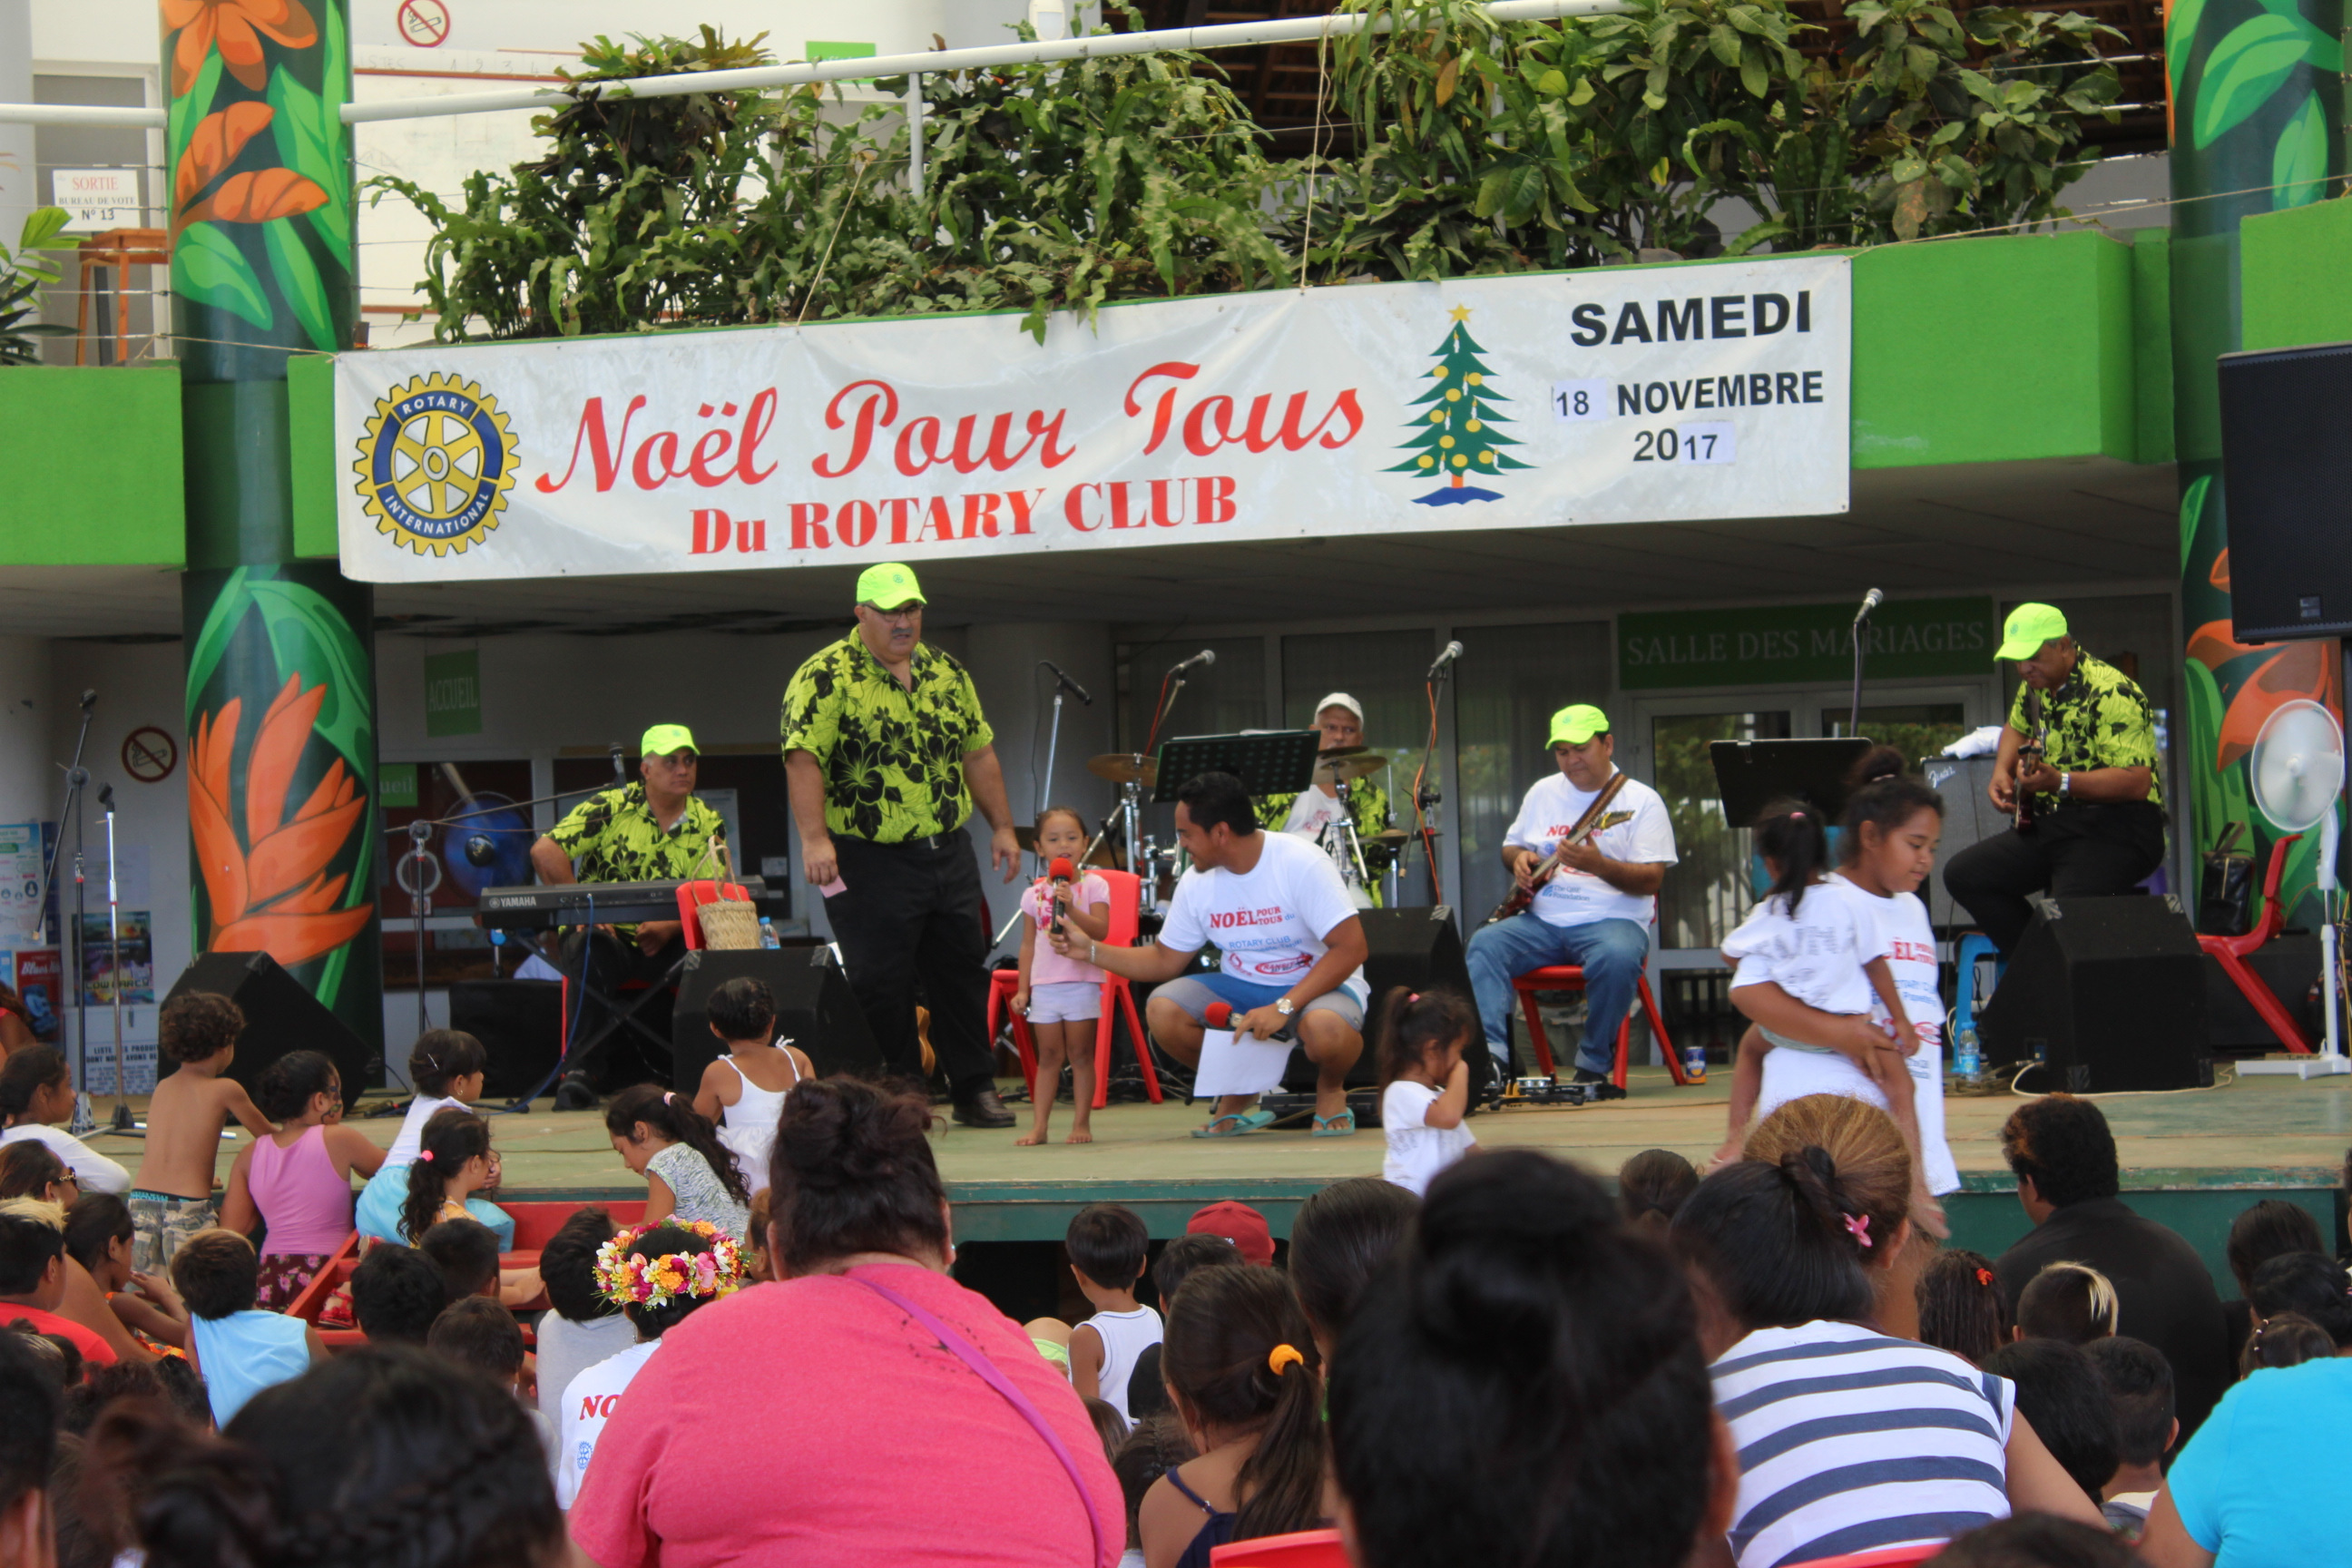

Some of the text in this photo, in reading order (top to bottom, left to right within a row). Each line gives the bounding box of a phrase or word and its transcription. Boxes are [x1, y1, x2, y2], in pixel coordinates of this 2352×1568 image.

[73, 177, 119, 191] SORTIE
[59, 197, 136, 205] BUREAU DE VOTE
[101, 209, 114, 220] 13
[1571, 290, 1811, 347] SAMEDI
[1555, 370, 1825, 416] 18 NOVEMBRE
[402, 396, 468, 415] ROTARY
[534, 361, 1364, 494] Noël Pour Tous
[1632, 427, 1719, 463] 2017
[385, 493, 489, 534] INTERNATIONAL
[688, 475, 1237, 554] Du ROTARY CLUB
[1627, 621, 1984, 665] SALLE DES MARIAGES
[428, 677, 477, 712] ACCUEIL
[379, 776, 413, 794] ueil
[1546, 825, 1570, 837] NO
[500, 896, 537, 907] YAMAHA
[1257, 906, 1281, 916] POUR
[1258, 913, 1295, 925] TOUS du
[1229, 938, 1263, 949] ROTARY
[1265, 936, 1291, 946] CLUB
[93, 1046, 112, 1054] LISTE
[579, 1395, 622, 1420] NO
